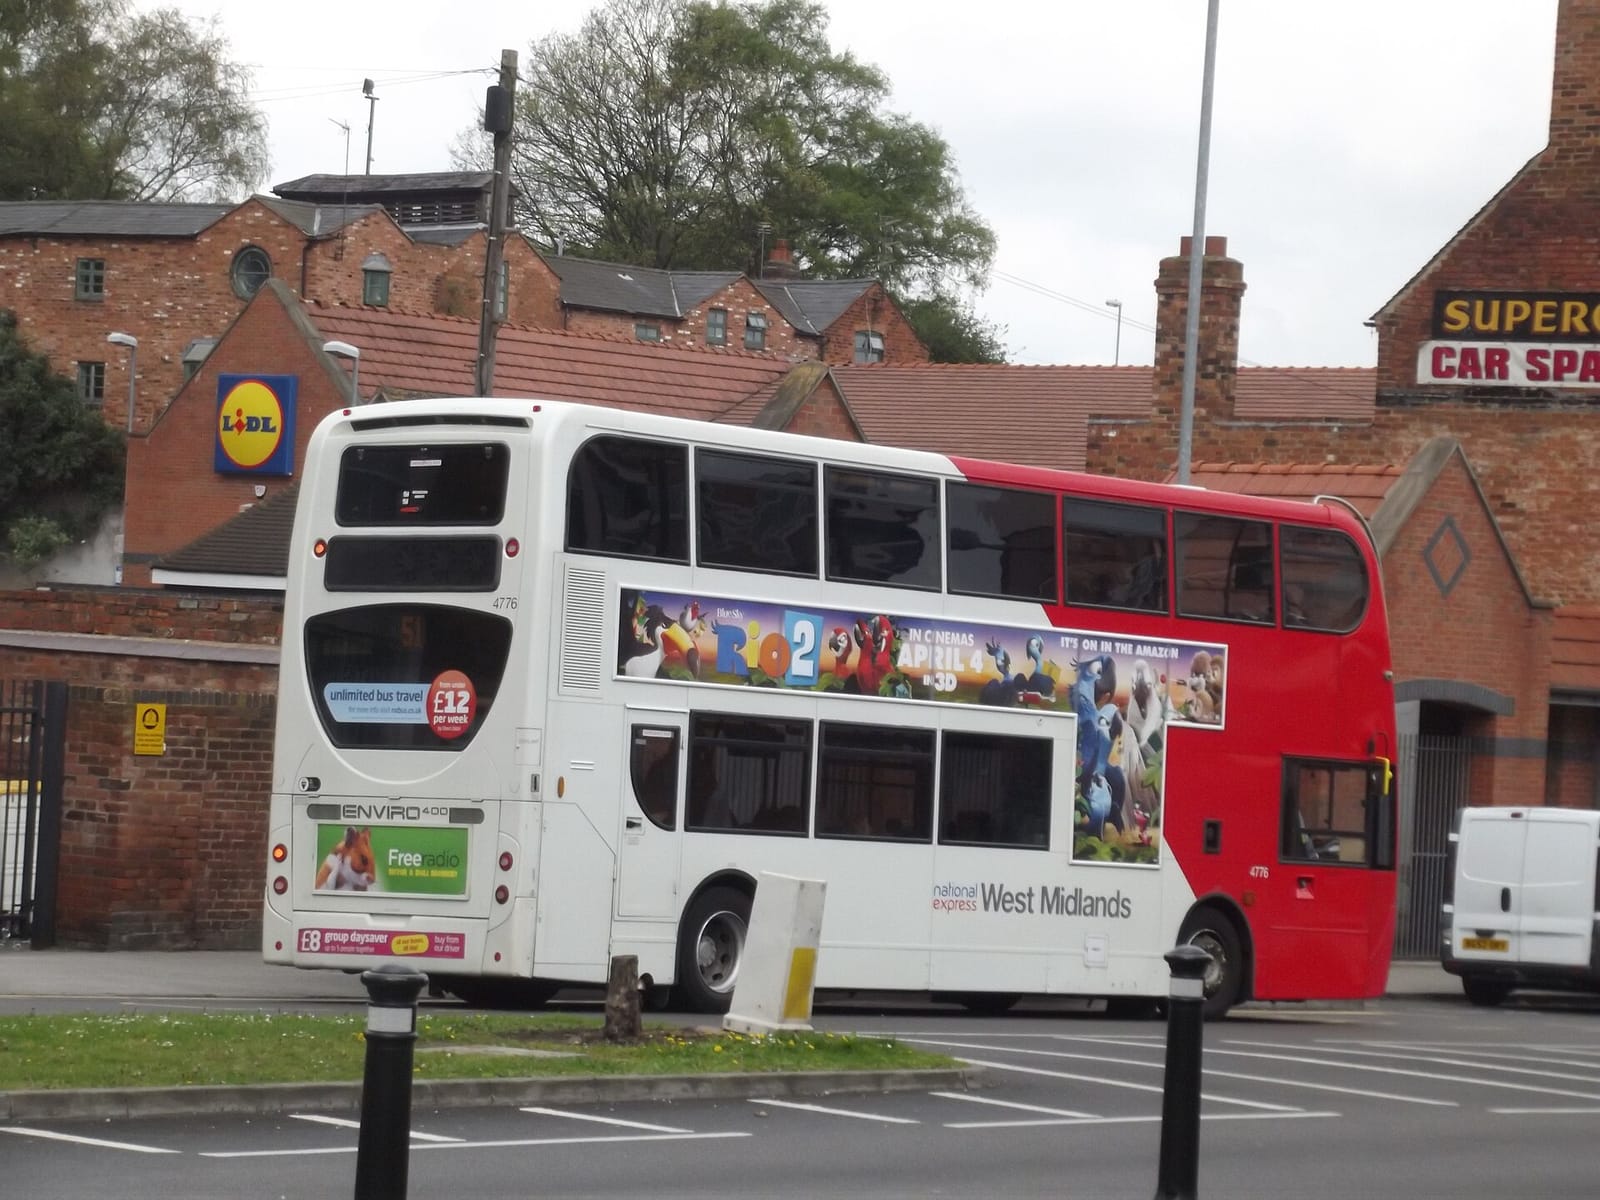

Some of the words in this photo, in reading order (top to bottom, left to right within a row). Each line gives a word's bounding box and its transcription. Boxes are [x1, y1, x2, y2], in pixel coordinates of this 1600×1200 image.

[1432, 347, 1509, 380] CAR
[493, 597, 517, 610] 4776
[909, 628, 921, 642] IN
[792, 620, 815, 677] 2
[1060, 636, 1078, 649] IT'S
[1082, 639, 1098, 652] ON
[1101, 640, 1112, 653] IN
[1115, 642, 1133, 655] THE
[897, 642, 965, 672] APRIL
[970, 649, 984, 674] 4
[934, 672, 958, 692] 3D
[330, 688, 375, 702] unlimited
[376, 689, 394, 702] bus
[396, 690, 423, 702] travel
[434, 690, 470, 713] £12
[433, 715, 446, 725] per
[447, 714, 468, 724] week
[342, 804, 421, 820] ENVIRO
[422, 806, 449, 816] 400
[1249, 866, 1269, 879] 4776
[933, 883, 978, 898] national
[932, 897, 977, 912] express
[981, 882, 1035, 914] West
[1040, 885, 1132, 918] Midlands
[301, 930, 321, 952] £8
[324, 932, 349, 944] group
[350, 931, 388, 945] daysaver
